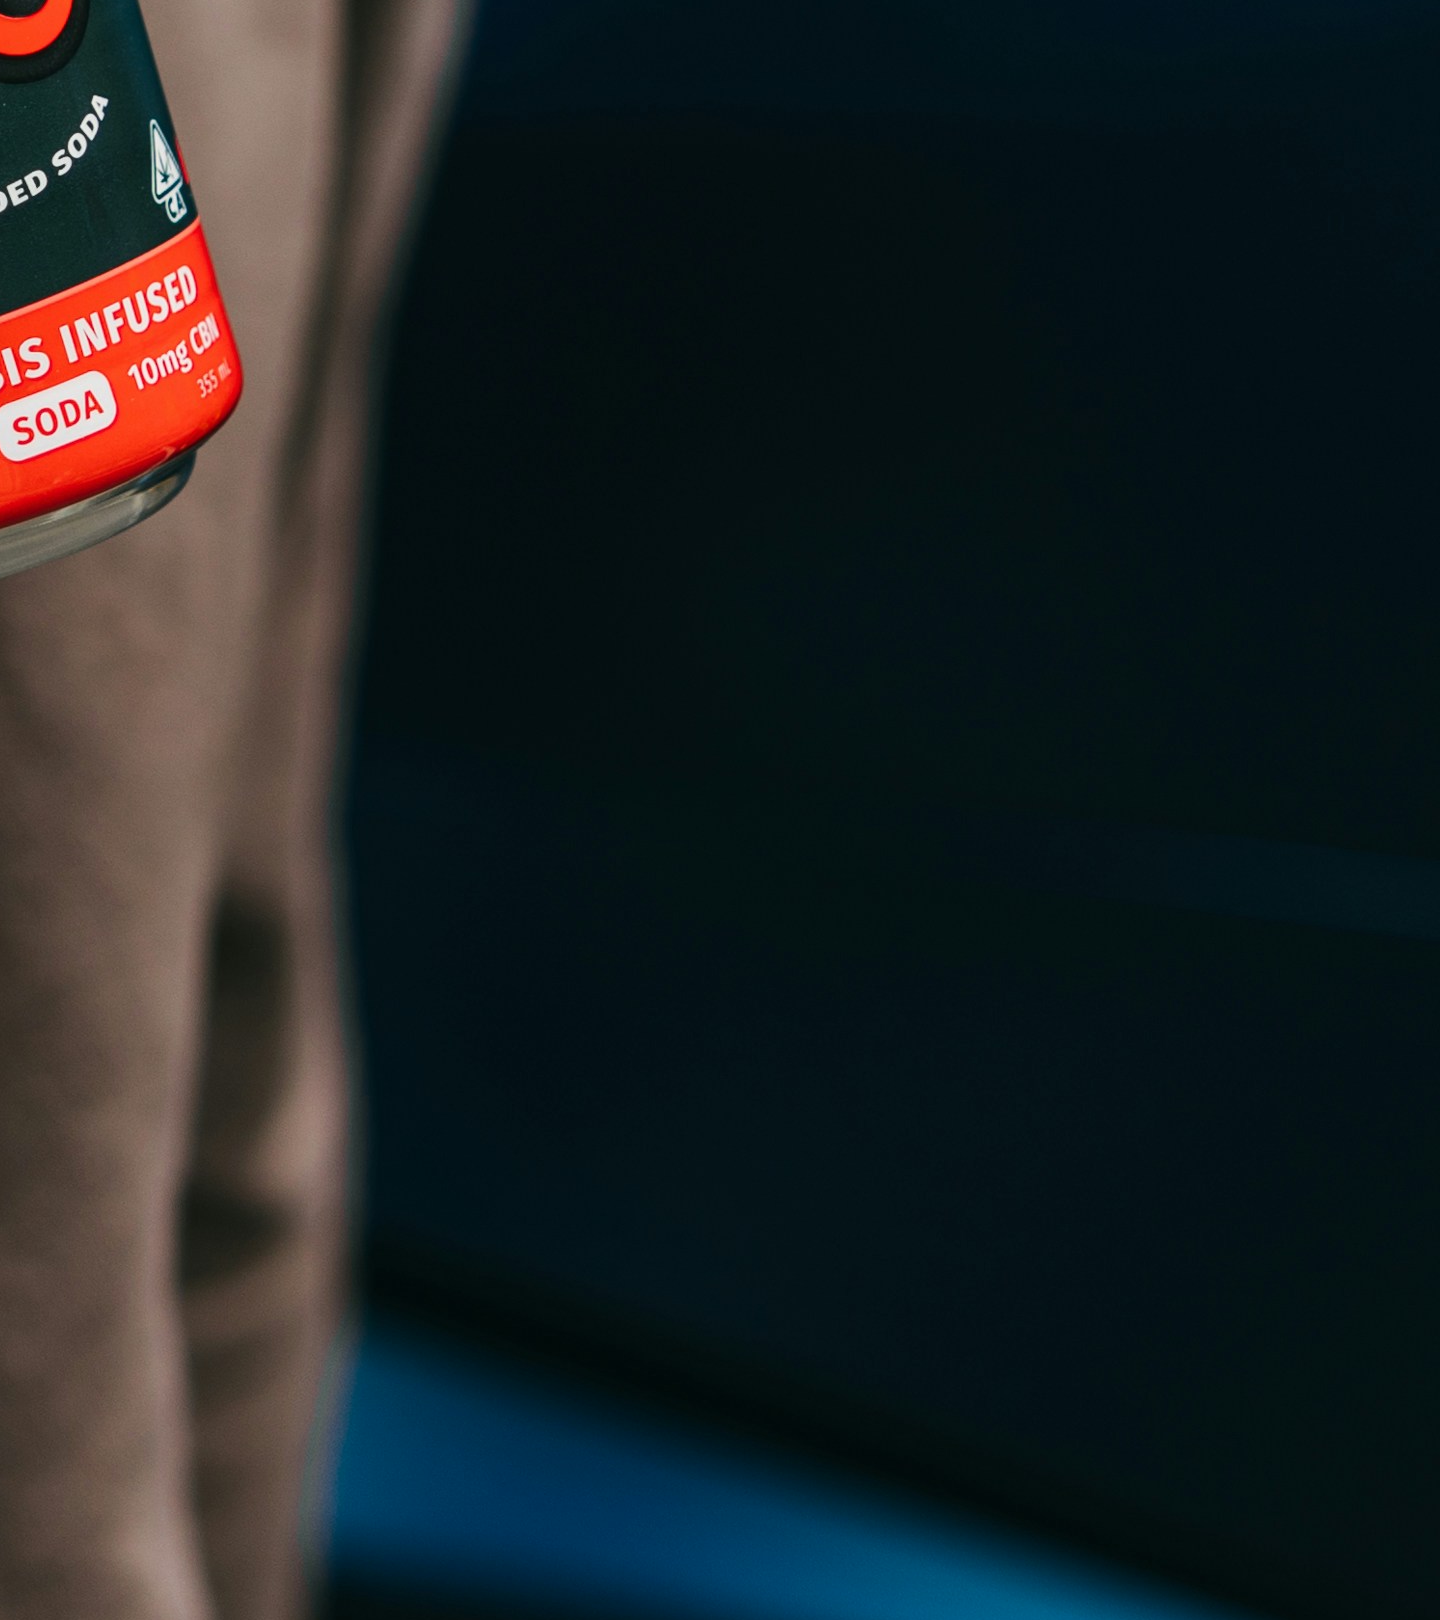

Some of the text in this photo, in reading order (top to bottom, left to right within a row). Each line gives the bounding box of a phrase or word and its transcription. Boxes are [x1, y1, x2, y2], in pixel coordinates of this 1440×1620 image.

[52, 95, 108, 175] SODA
[60, 266, 196, 362] INFUSED
[13, 391, 103, 445] SODA
[128, 340, 192, 389] 10mg
[197, 369, 217, 398] 355
